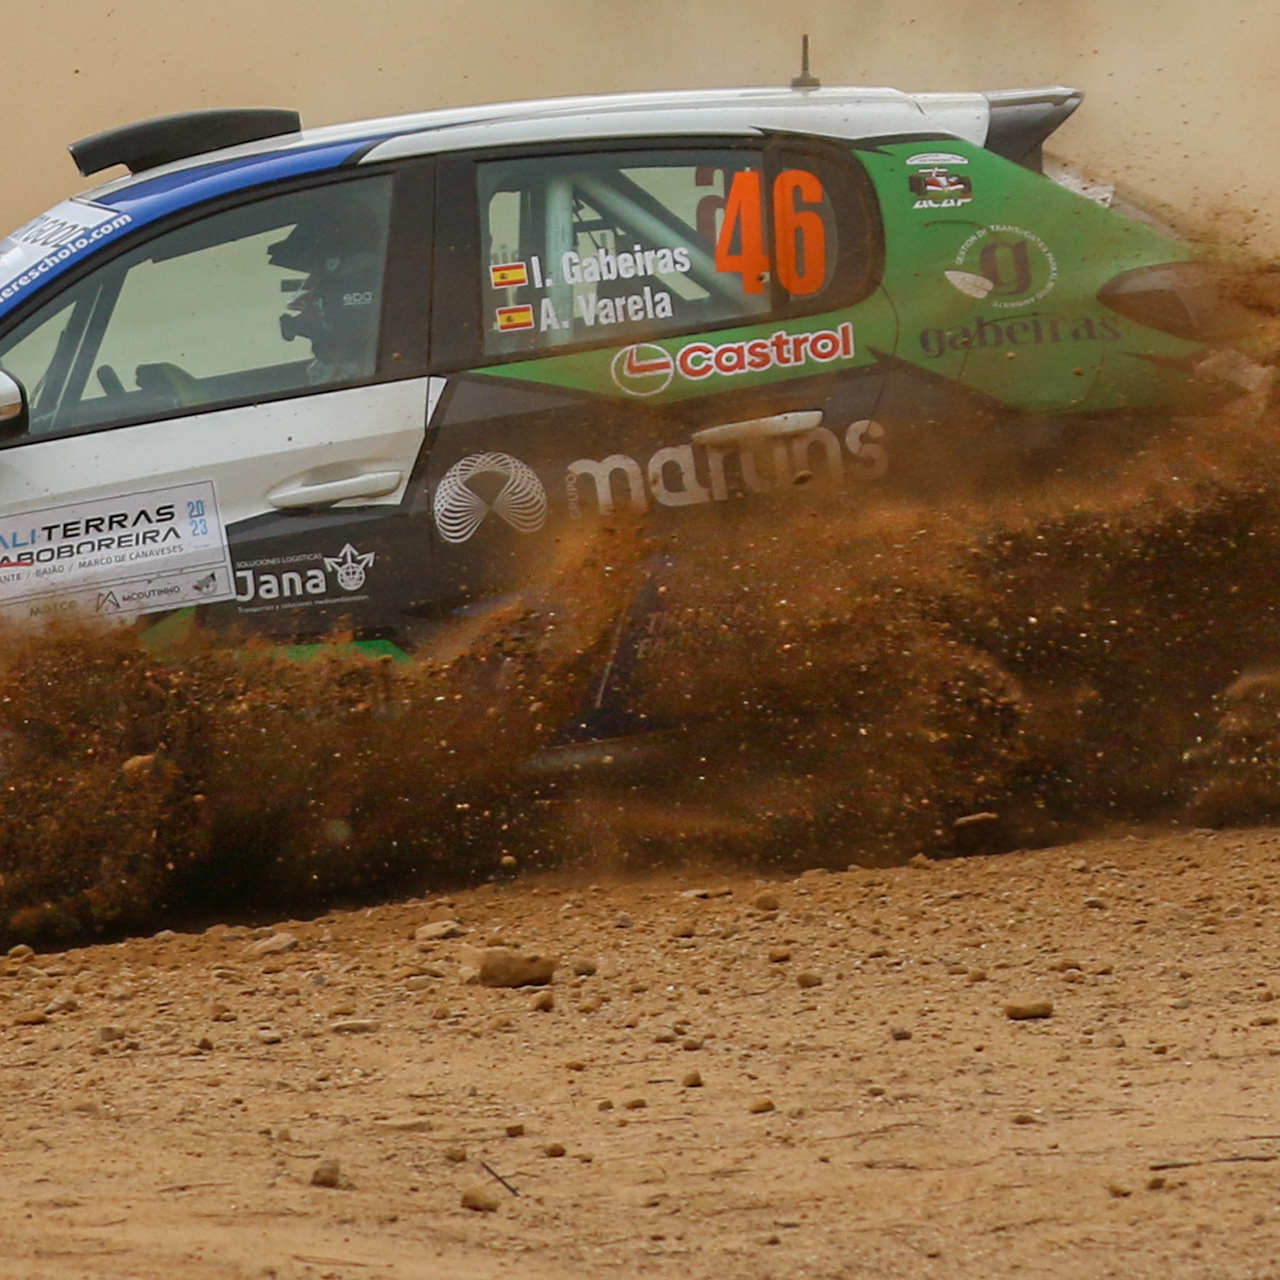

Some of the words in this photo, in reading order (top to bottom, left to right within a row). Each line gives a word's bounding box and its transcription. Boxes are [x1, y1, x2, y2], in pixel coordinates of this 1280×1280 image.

[715, 168, 827, 296] 46
[532, 255, 553, 289] I.
[563, 244, 692, 286] Gabeiras
[539, 297, 570, 332] A.
[580, 286, 674, 328] Varela
[678, 322, 855, 382] Castrol
[919, 315, 1123, 359] gabeiras
[41, 504, 176, 542] TERRAS
[78, 554, 113, 569] MARCO
[129, 543, 185, 561] CANAVESES
[122, 585, 181, 602] MCOUTINHO
[235, 568, 327, 602] Jana
